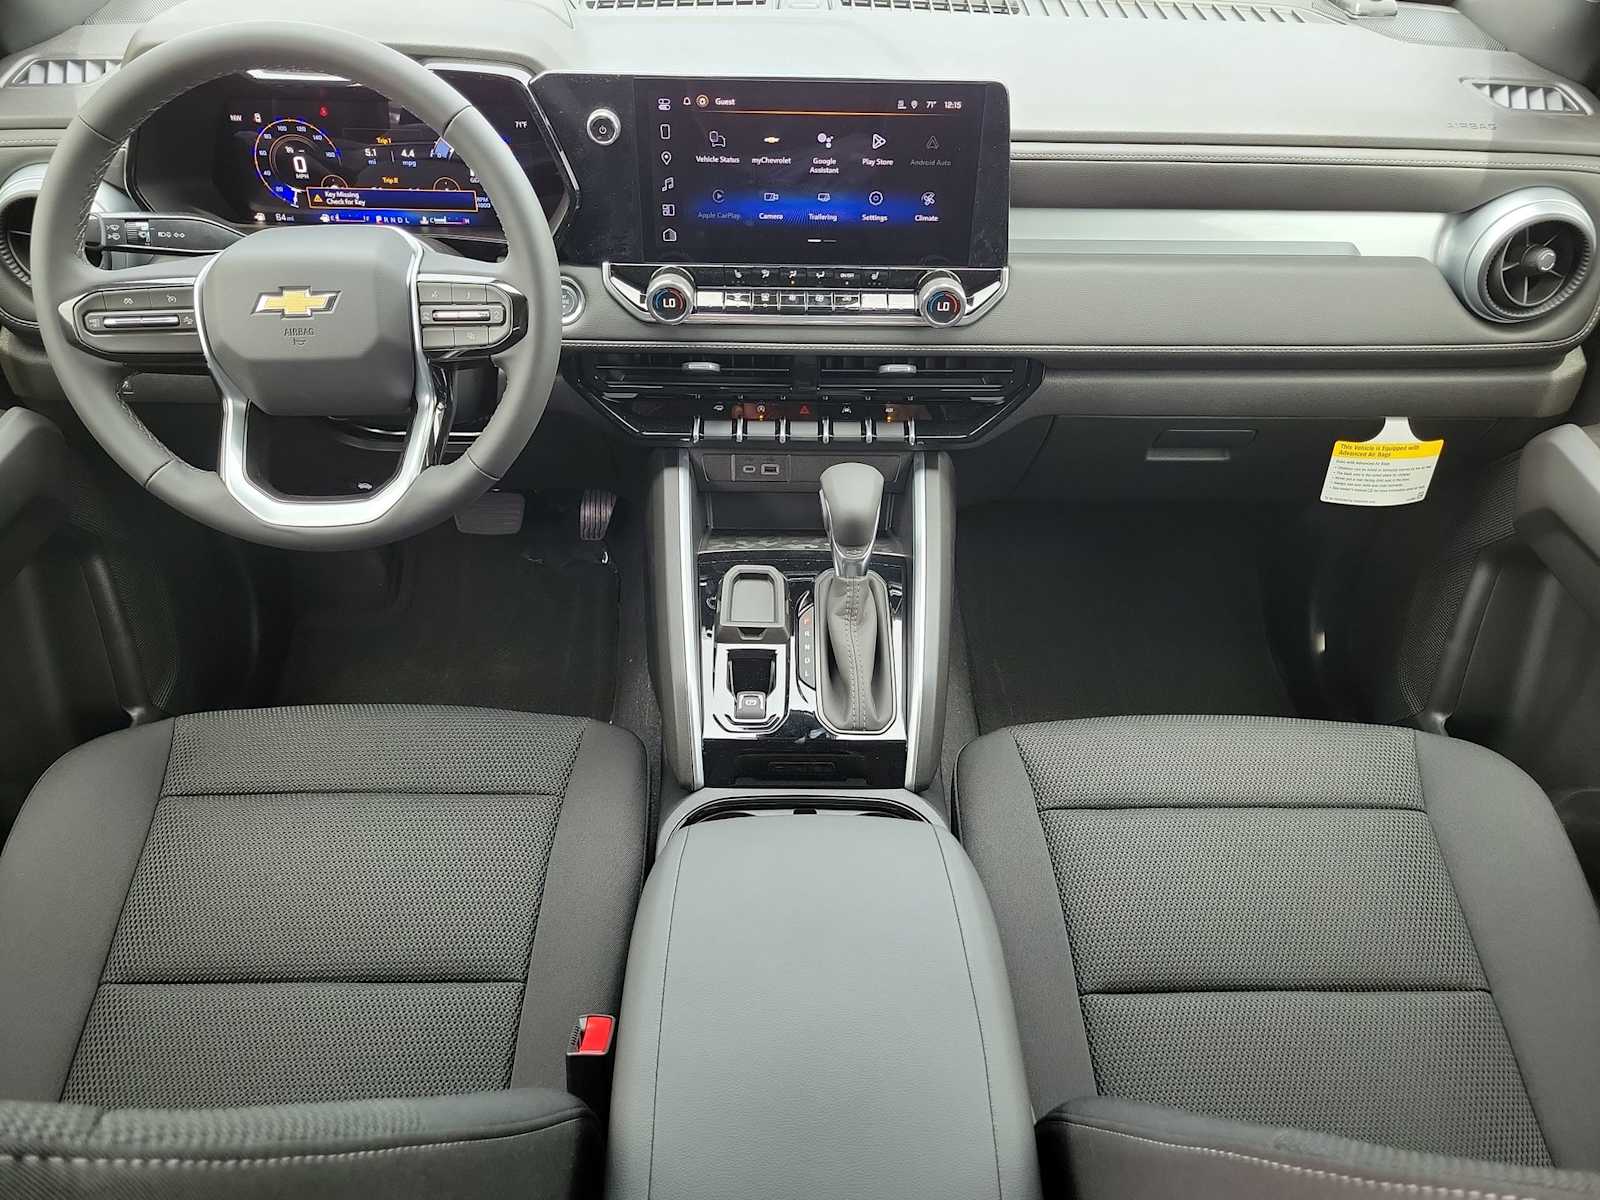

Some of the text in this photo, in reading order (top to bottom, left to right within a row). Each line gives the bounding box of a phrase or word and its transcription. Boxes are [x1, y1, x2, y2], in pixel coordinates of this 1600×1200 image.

[715, 97, 736, 106] Guest
[944, 100, 962, 109] 12:15
[376, 137, 388, 145] Trip
[364, 147, 377, 157] 5.1
[400, 148, 415, 158] 4.4
[402, 160, 417, 168] mpg
[695, 155, 740, 164] Vehicle Status
[751, 156, 792, 165] myChevrolet
[812, 157, 837, 166] Google
[862, 158, 894, 167] Play Store
[293, 156, 308, 173] 0
[809, 166, 840, 174] Assistant
[382, 176, 393, 184] Trip
[324, 191, 359, 200] Key Missing
[355, 199, 366, 207] Key
[697, 211, 740, 220] Apple CarPlay
[759, 212, 784, 220] Camera
[808, 213, 838, 222] Trailering
[862, 213, 888, 222] Settings
[914, 214, 939, 222] Climate
[283, 327, 314, 337] AIRBAG
